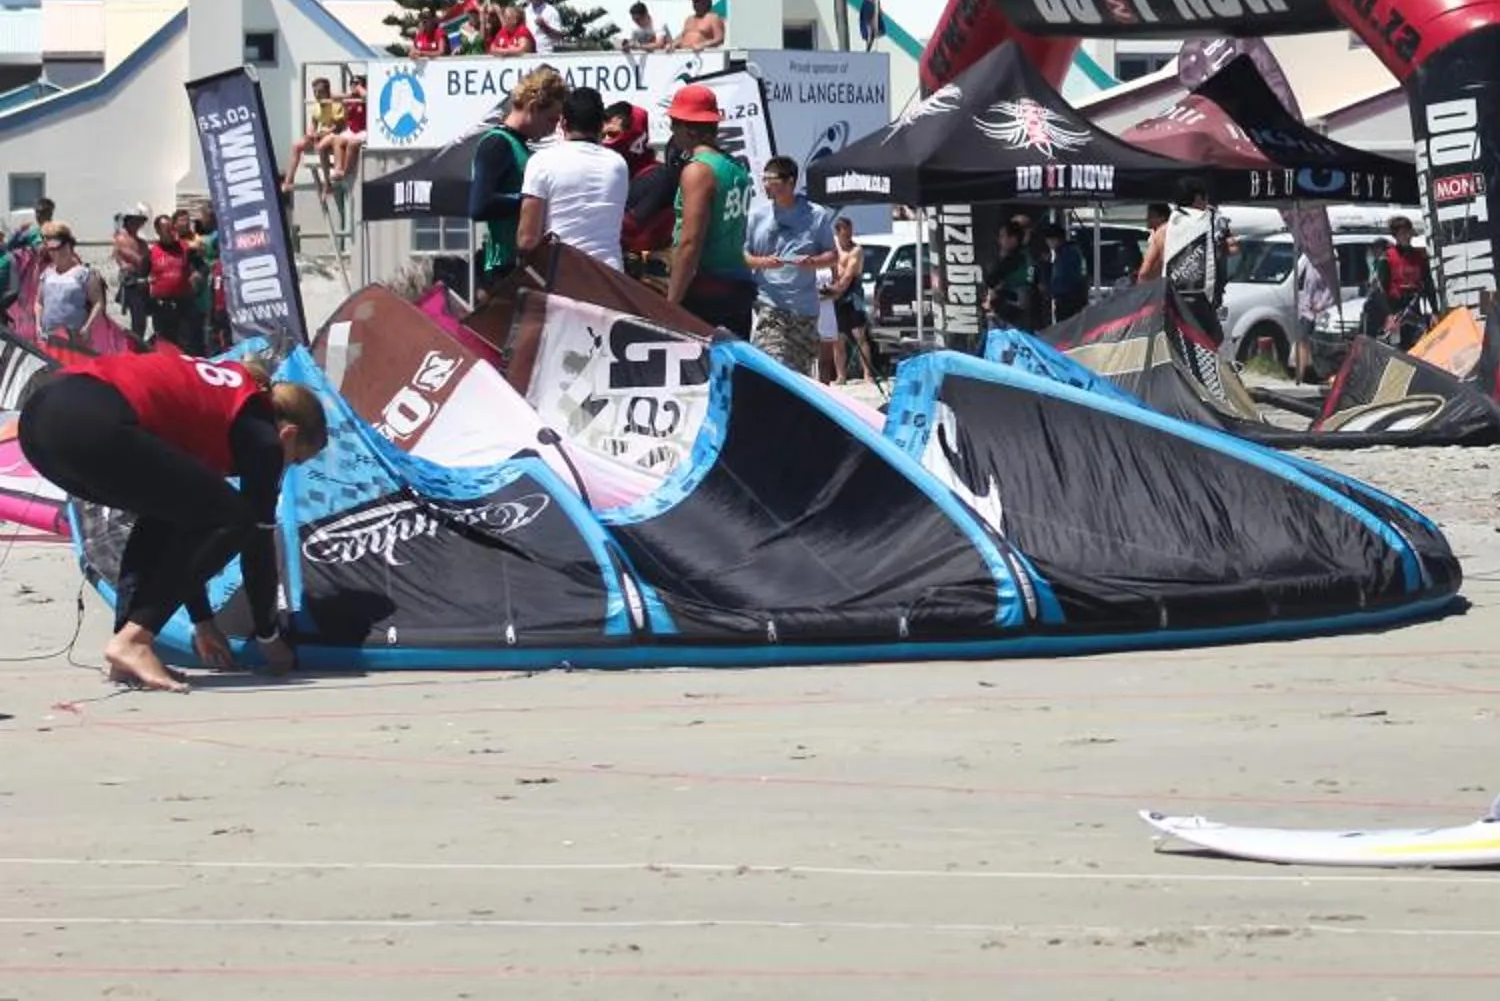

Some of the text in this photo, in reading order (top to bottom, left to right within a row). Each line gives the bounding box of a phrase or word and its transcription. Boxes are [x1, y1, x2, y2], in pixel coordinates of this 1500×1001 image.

[447, 69, 530, 96] BEAC
[553, 65, 649, 92] ATROL
[765, 81, 885, 103] EAM LANGEBAAN
[1426, 98, 1482, 166] DO
[1351, 172, 1393, 199] EYE
